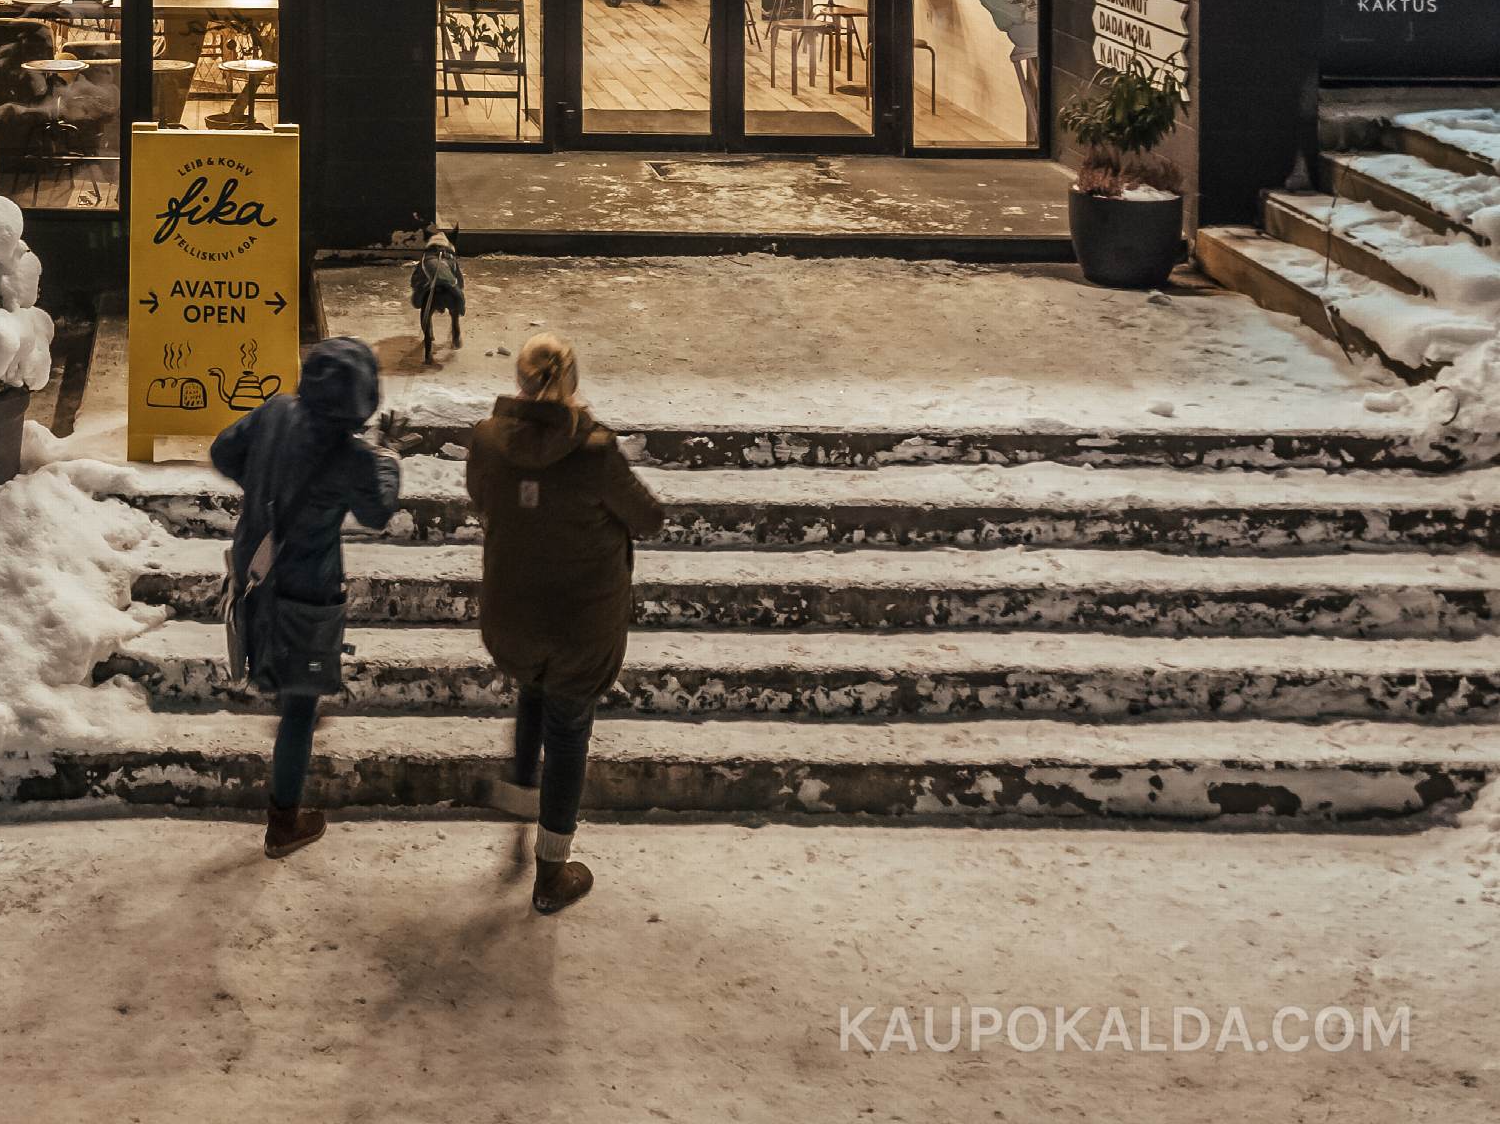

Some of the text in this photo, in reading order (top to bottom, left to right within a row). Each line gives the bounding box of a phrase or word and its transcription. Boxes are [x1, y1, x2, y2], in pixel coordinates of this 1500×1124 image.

[178, 157, 253, 177] LEIB & KOHV
[153, 176, 277, 245] fika
[172, 233, 258, 262] TELLISKIVI 60A
[170, 280, 260, 300] AVATUD
[183, 304, 246, 324] OPEN
